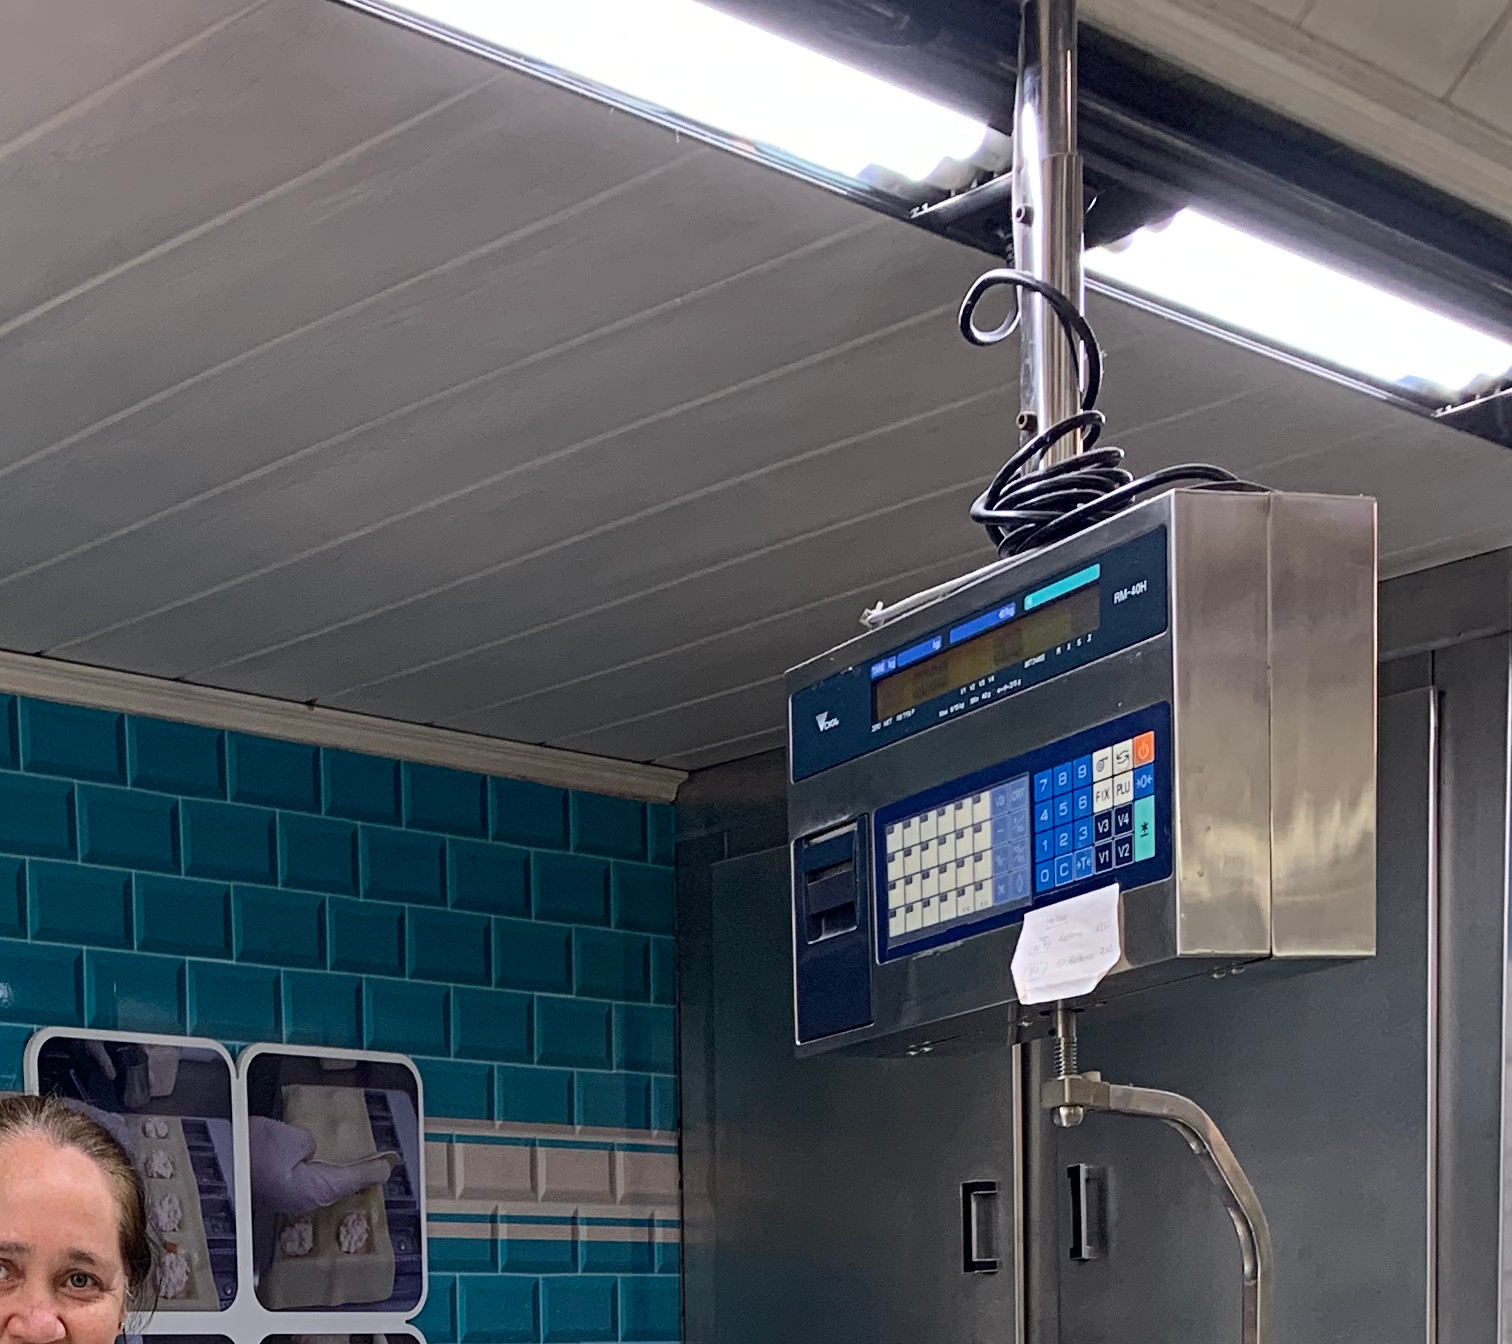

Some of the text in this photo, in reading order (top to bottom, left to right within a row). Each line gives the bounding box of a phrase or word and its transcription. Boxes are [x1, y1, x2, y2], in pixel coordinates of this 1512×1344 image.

[1113, 580, 1148, 604] RM-40H
[1040, 779, 1048, 793] 7
[1058, 772, 1067, 786] 8
[1077, 765, 1086, 780] 9
[1040, 780, 1131, 822] 4 5 6 FIX PLU
[1042, 812, 1130, 853] 1 2 3 V3 V4
[1059, 862, 1069, 877] C
[1098, 849, 1110, 863] V1
[1117, 843, 1130, 858] V2
